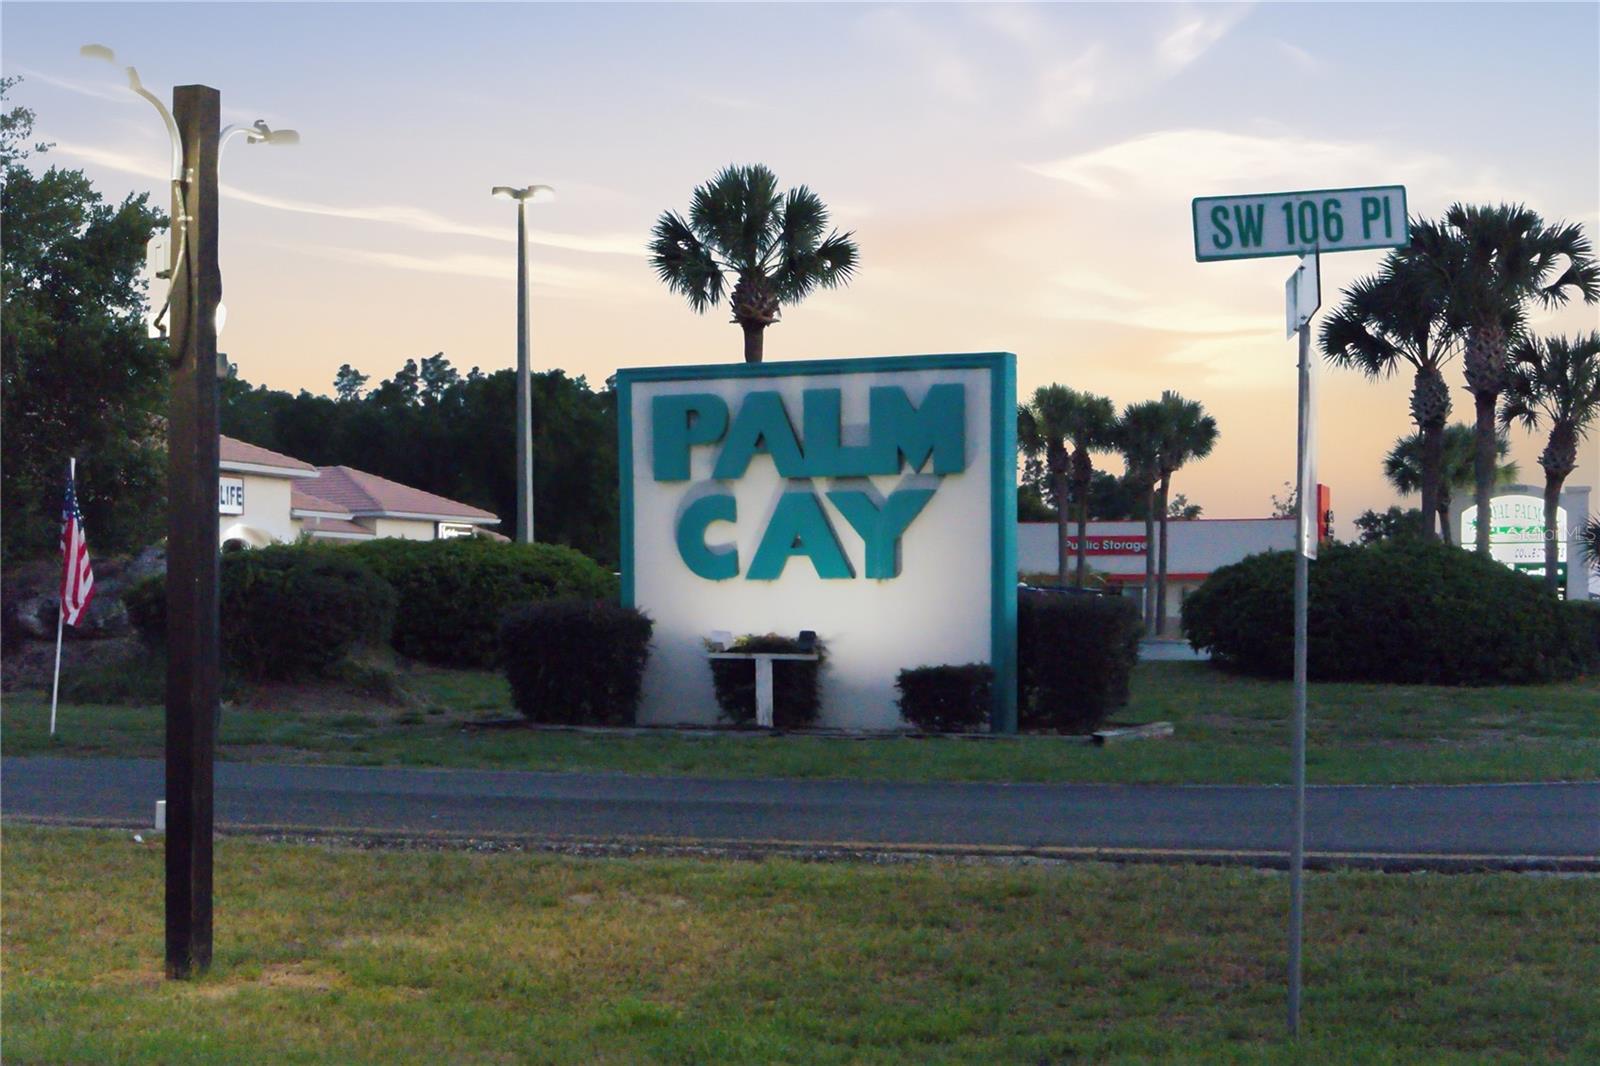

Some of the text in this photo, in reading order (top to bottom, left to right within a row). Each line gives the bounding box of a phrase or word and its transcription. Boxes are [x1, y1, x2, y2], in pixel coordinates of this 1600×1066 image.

[1211, 204, 1264, 250] SW
[1282, 198, 1344, 245] 106
[653, 383, 965, 482] PALM
[220, 484, 242, 504] LIFE
[677, 488, 937, 581] CAY
[1064, 540, 1148, 552] Pulic Storage
